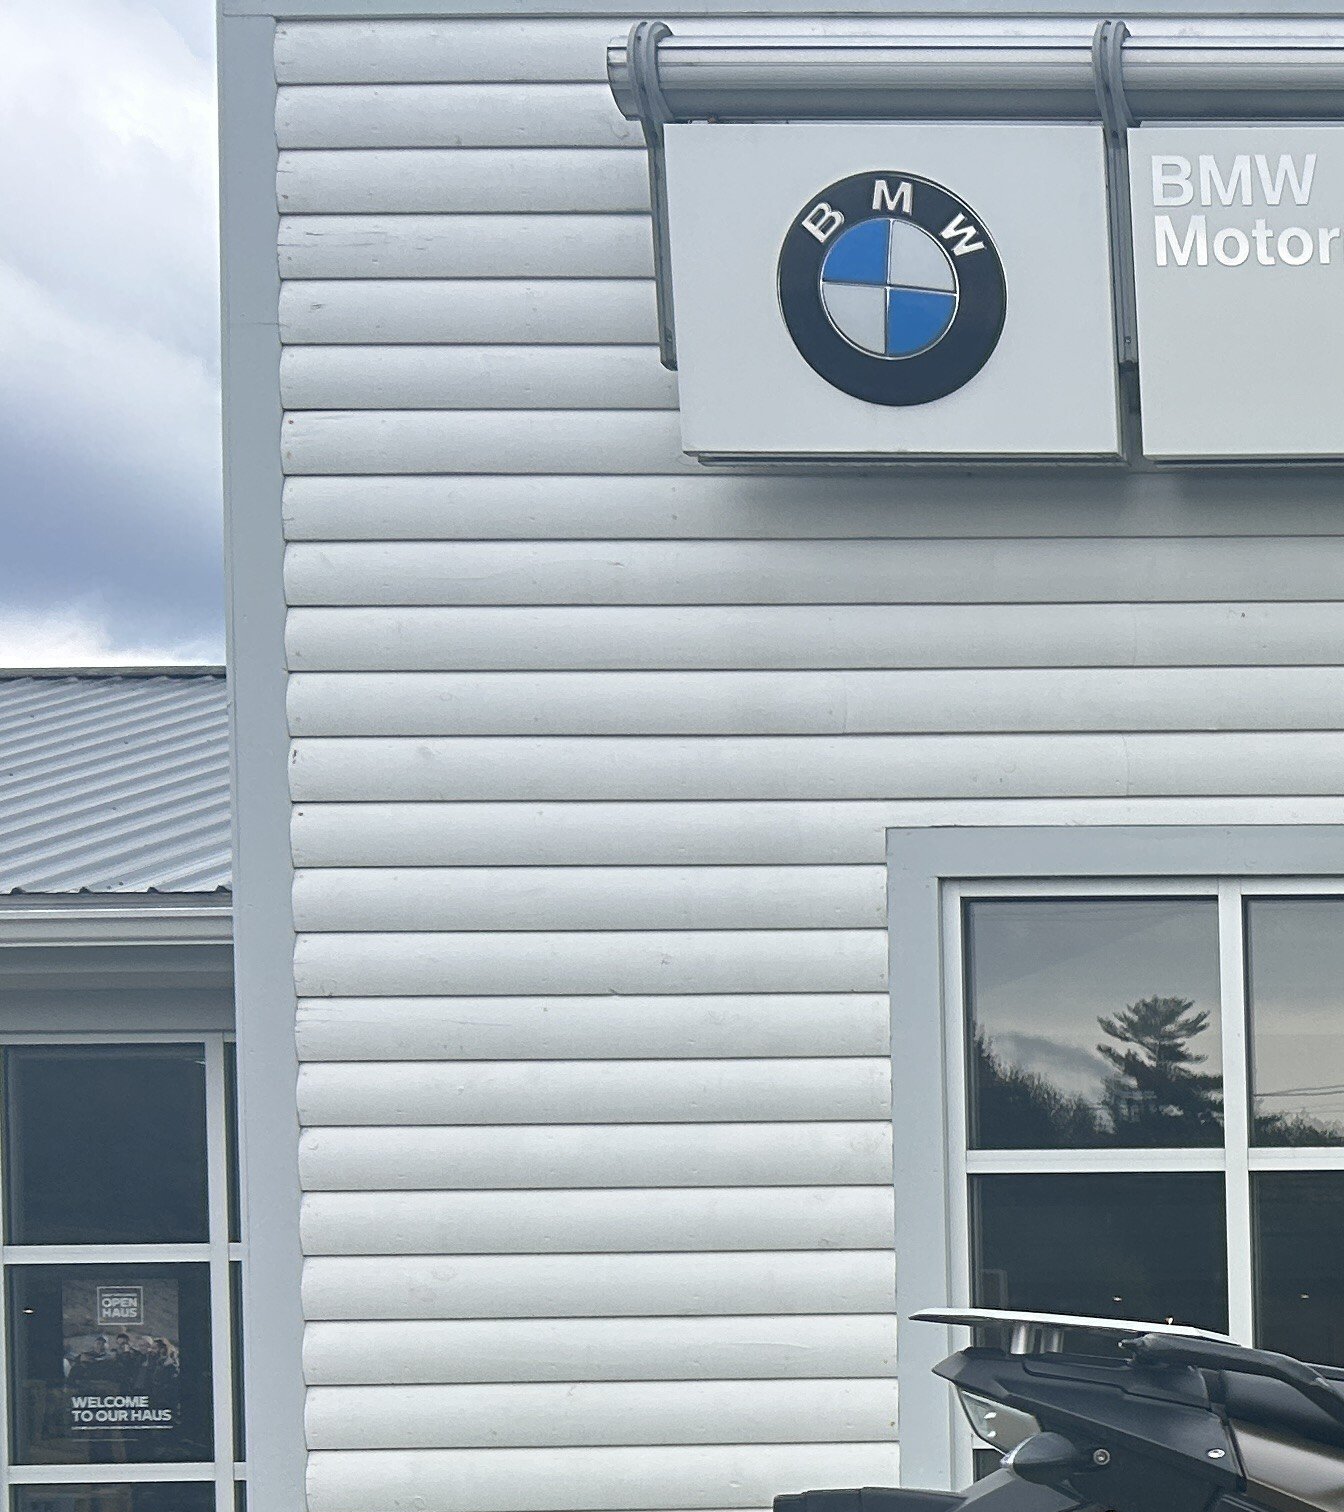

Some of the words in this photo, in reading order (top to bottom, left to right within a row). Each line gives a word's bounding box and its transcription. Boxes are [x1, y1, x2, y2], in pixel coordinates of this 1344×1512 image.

[1151, 153, 1317, 207] BMW
[802, 178, 987, 259] BMW
[101, 1298, 138, 1308] OPEN
[101, 1308, 138, 1318] HAUS
[71, 1396, 149, 1408] WELCOME
[71, 1410, 93, 1422] TO
[95, 1410, 128, 1422] OUR
[131, 1409, 172, 1421] HAUS
